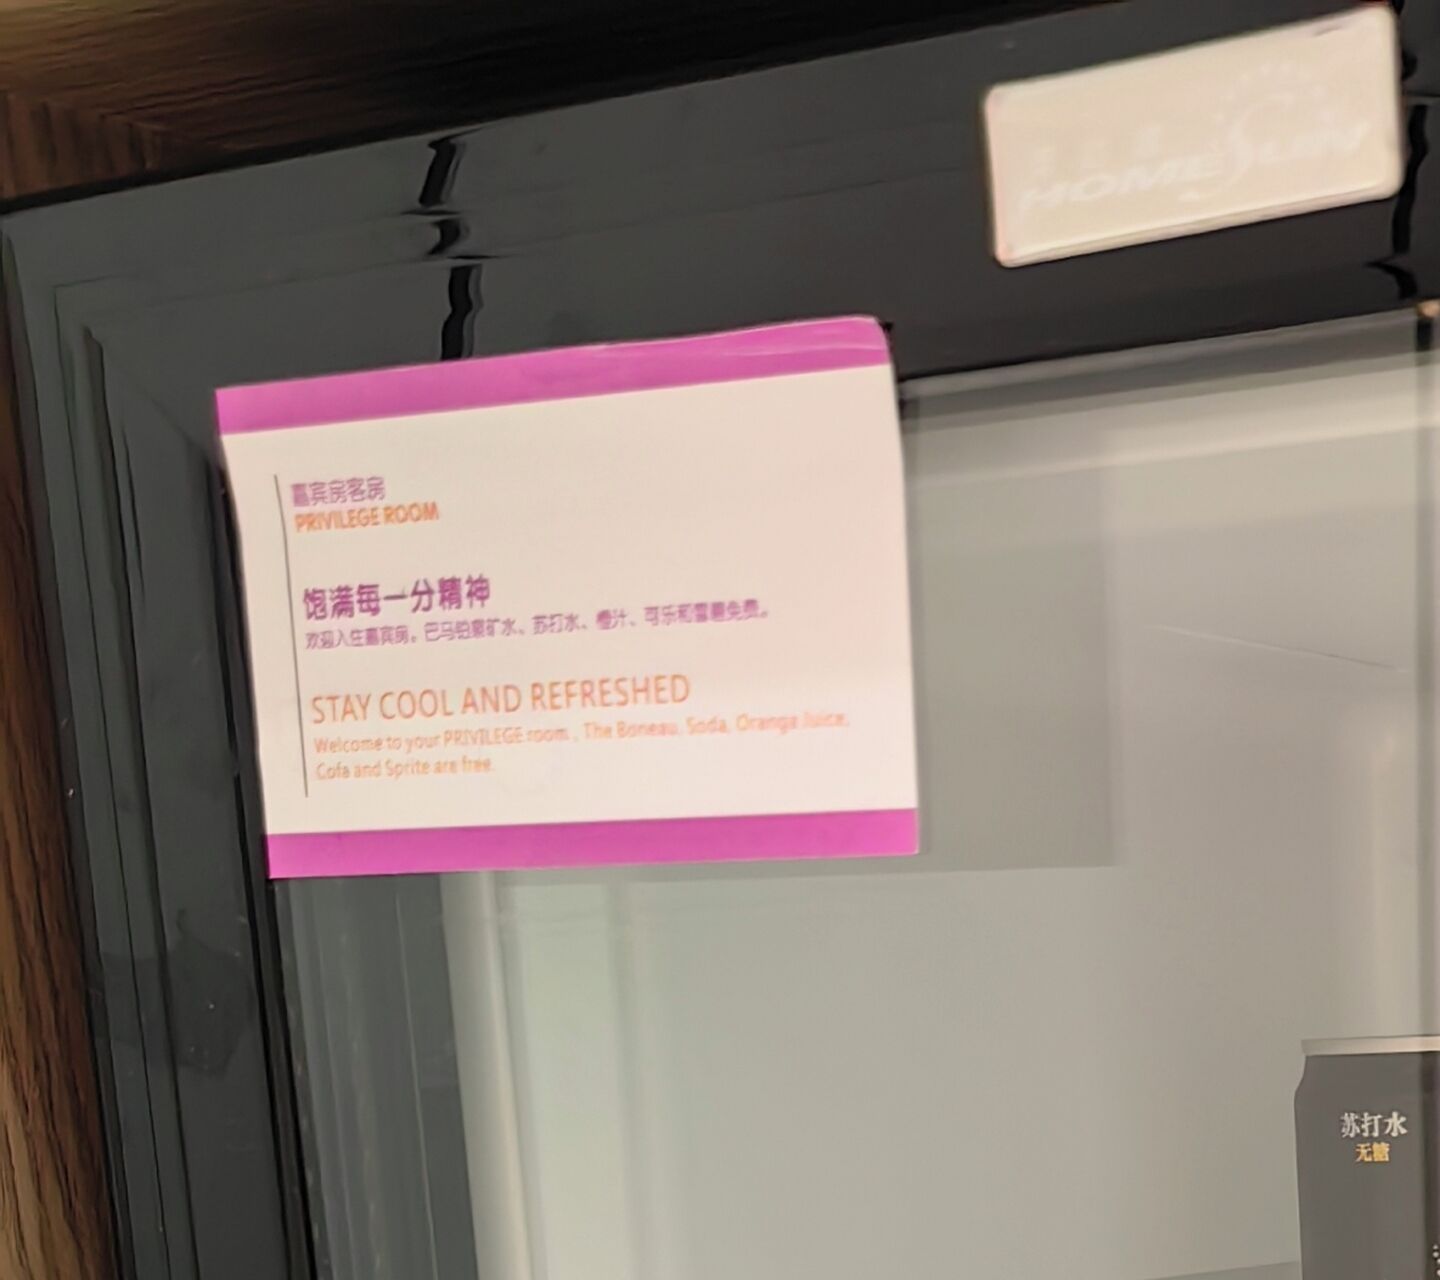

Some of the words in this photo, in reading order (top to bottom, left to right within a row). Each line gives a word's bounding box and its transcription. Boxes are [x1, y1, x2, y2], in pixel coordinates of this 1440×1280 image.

[295, 507, 381, 533] PRIVILEGE
[383, 501, 440, 524] ROOM
[304, 575, 490, 619] 饱满每一分精神
[311, 693, 372, 724] STAY
[379, 689, 454, 720] COOL
[461, 684, 522, 714] AND
[531, 674, 690, 712] REFRESHED
[313, 735, 384, 754] Welcome
[387, 735, 402, 751] to
[405, 733, 440, 754] your
[443, 727, 523, 748] PRIVILEGE
[584, 720, 612, 739] The
[736, 712, 799, 736] Orange
[353, 758, 382, 779] and
[385, 756, 430, 781] Sprite
[432, 759, 457, 775] are
[1341, 1111, 1408, 1138] 苏打水
[1356, 1142, 1390, 1162] 无糖
